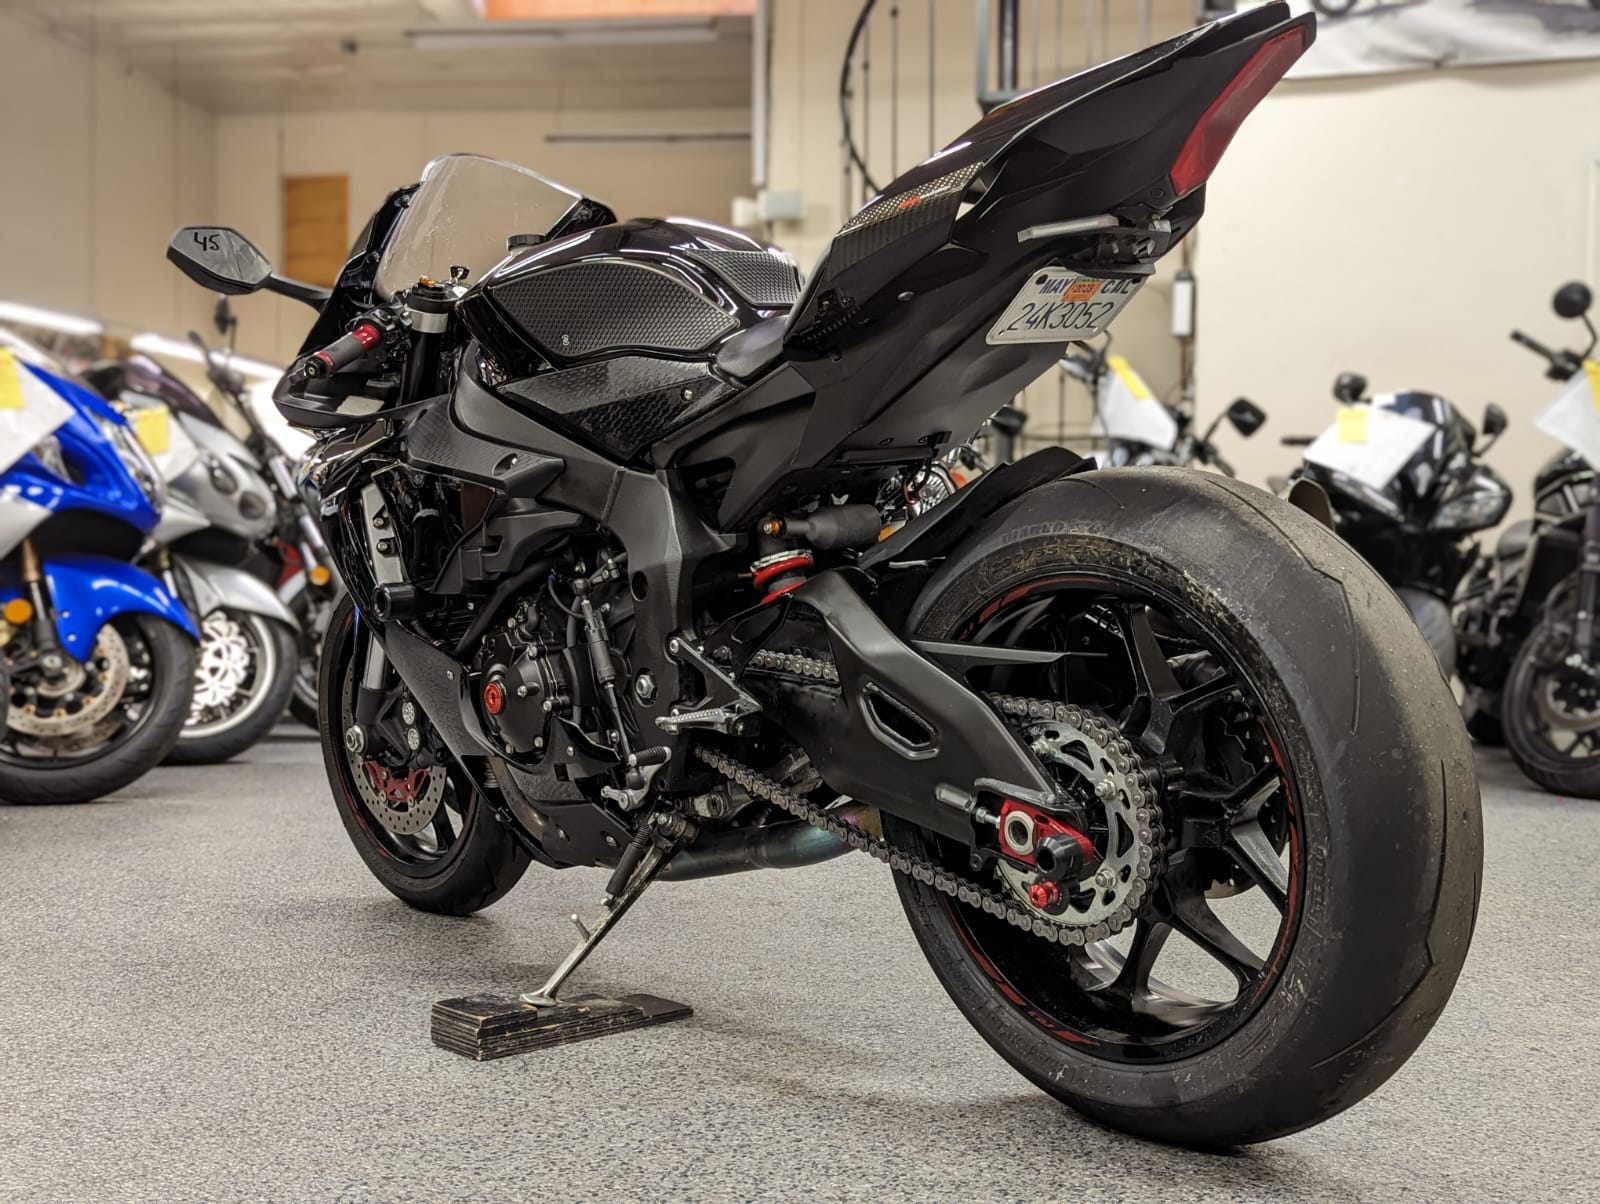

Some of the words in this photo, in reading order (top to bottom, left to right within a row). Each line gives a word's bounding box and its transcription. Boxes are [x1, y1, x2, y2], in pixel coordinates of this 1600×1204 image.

[194, 232, 221, 252] 45
[1039, 279, 1074, 295] MAY
[1101, 279, 1132, 295] CAL
[1006, 301, 1115, 331] 24K3052
